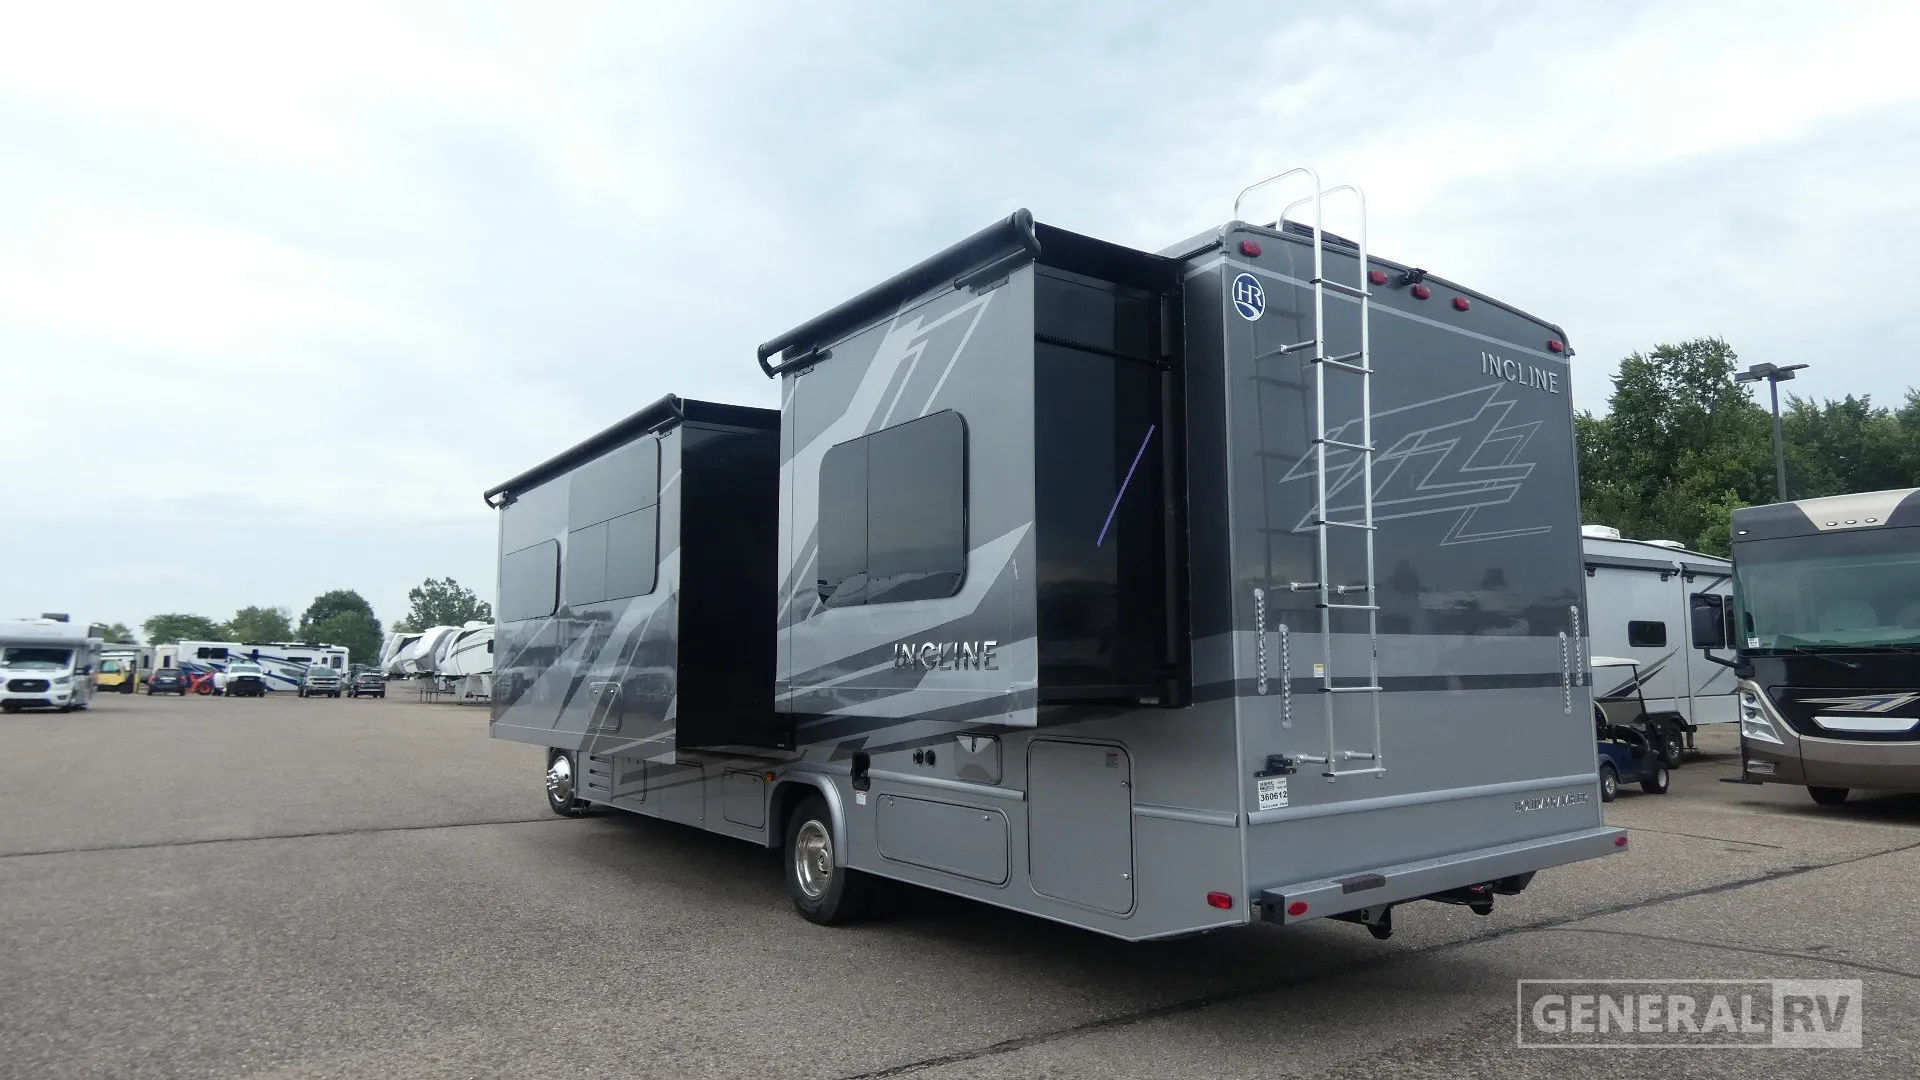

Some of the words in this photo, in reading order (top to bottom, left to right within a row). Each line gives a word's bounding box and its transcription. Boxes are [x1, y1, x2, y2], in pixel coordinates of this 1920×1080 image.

[1237, 280, 1262, 307] HR
[1481, 351, 1559, 394] INCLINE
[894, 640, 999, 671] INCLINE
[1260, 791, 1288, 801] 360612
